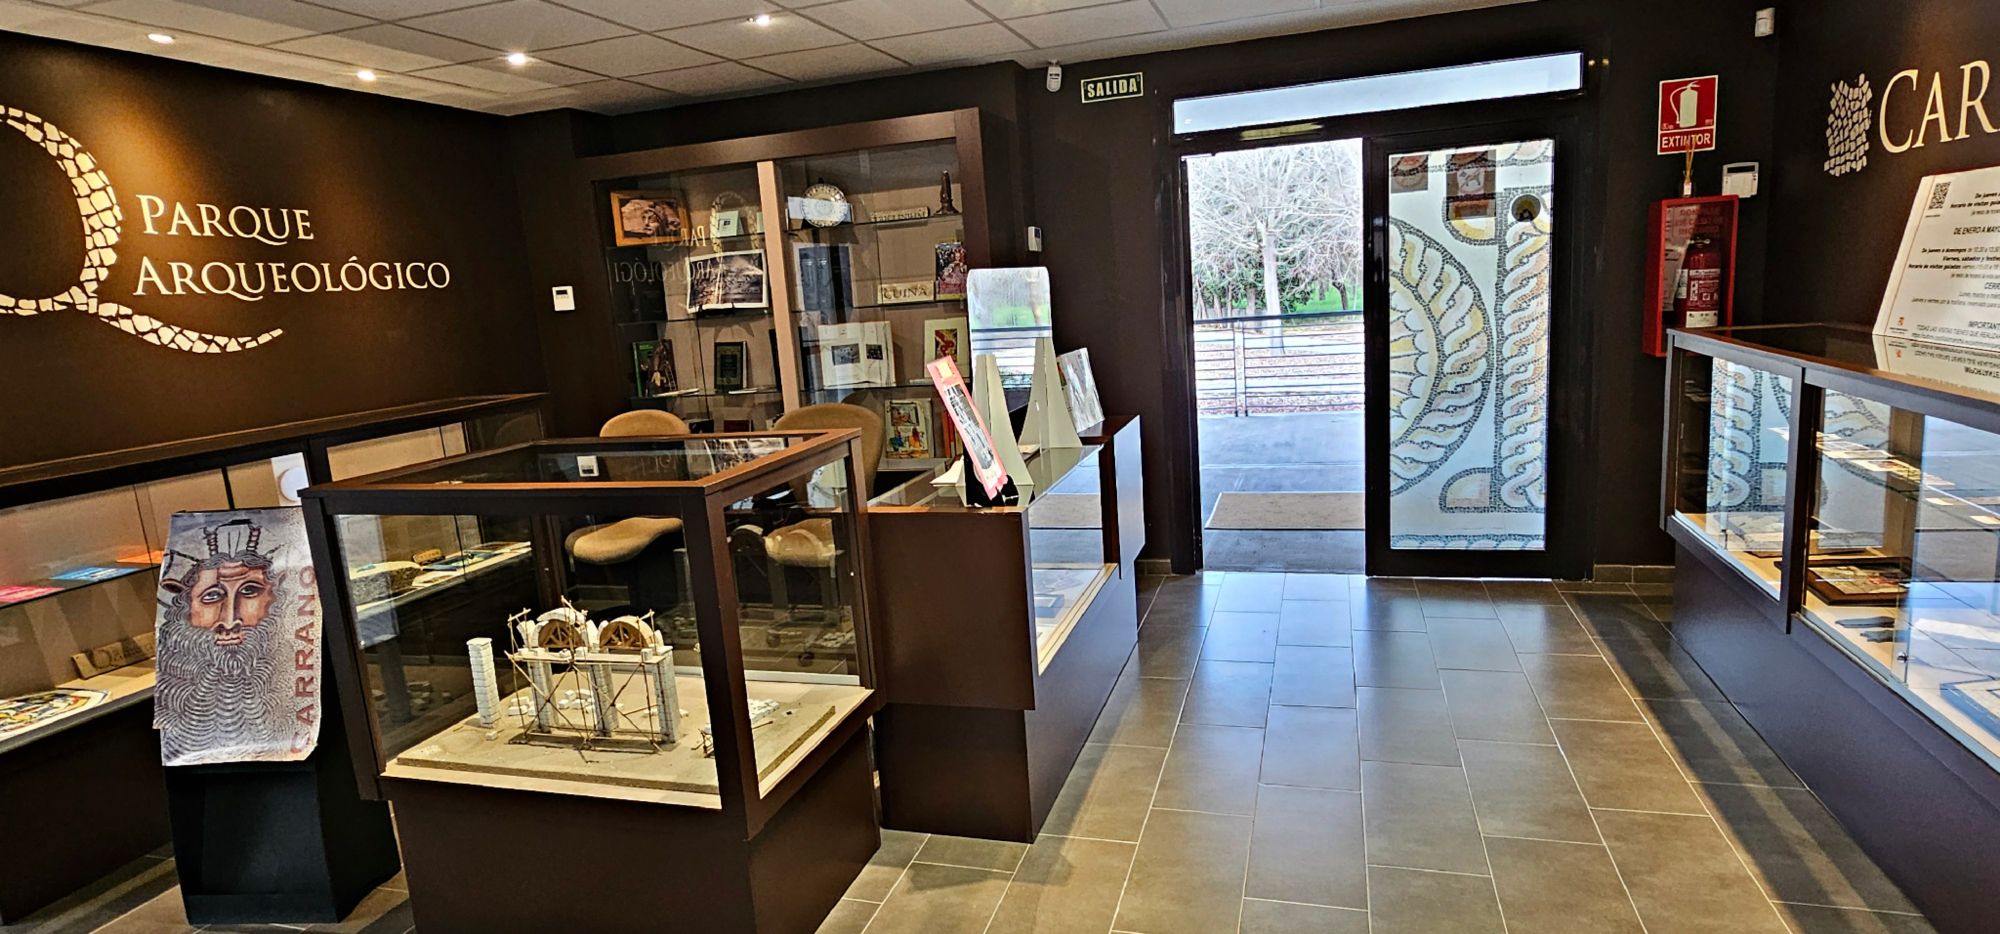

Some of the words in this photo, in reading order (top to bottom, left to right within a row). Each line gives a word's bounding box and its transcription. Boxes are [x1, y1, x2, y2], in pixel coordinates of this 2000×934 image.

[1087, 77, 1138, 98] SALIDA
[1661, 132, 1711, 149] EXTINTOR
[135, 194, 315, 246] PARQUE
[132, 255, 451, 301] ARQUEOLÓGICO
